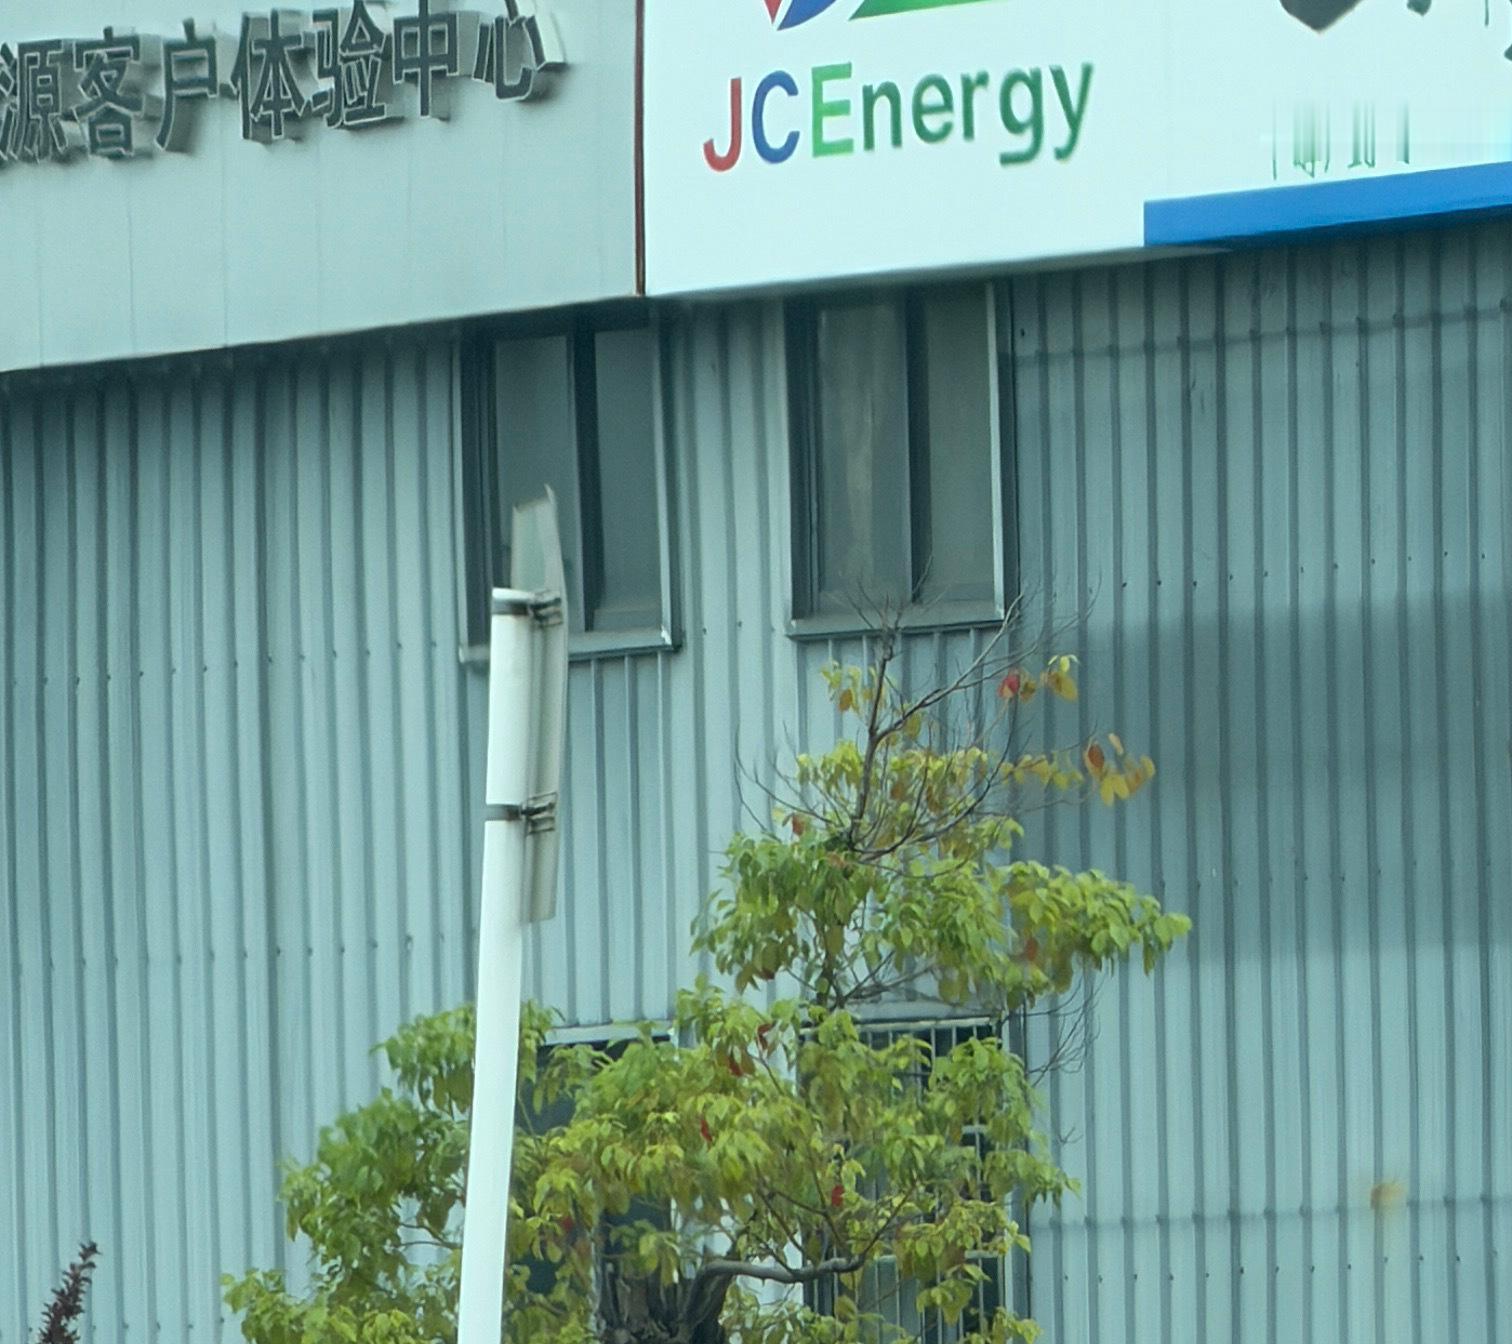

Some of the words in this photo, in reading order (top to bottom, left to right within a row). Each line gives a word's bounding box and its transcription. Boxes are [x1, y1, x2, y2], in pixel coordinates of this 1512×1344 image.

[0, 0, 554, 162] 源客户体验中心
[704, 62, 1094, 172] JCEnergy
